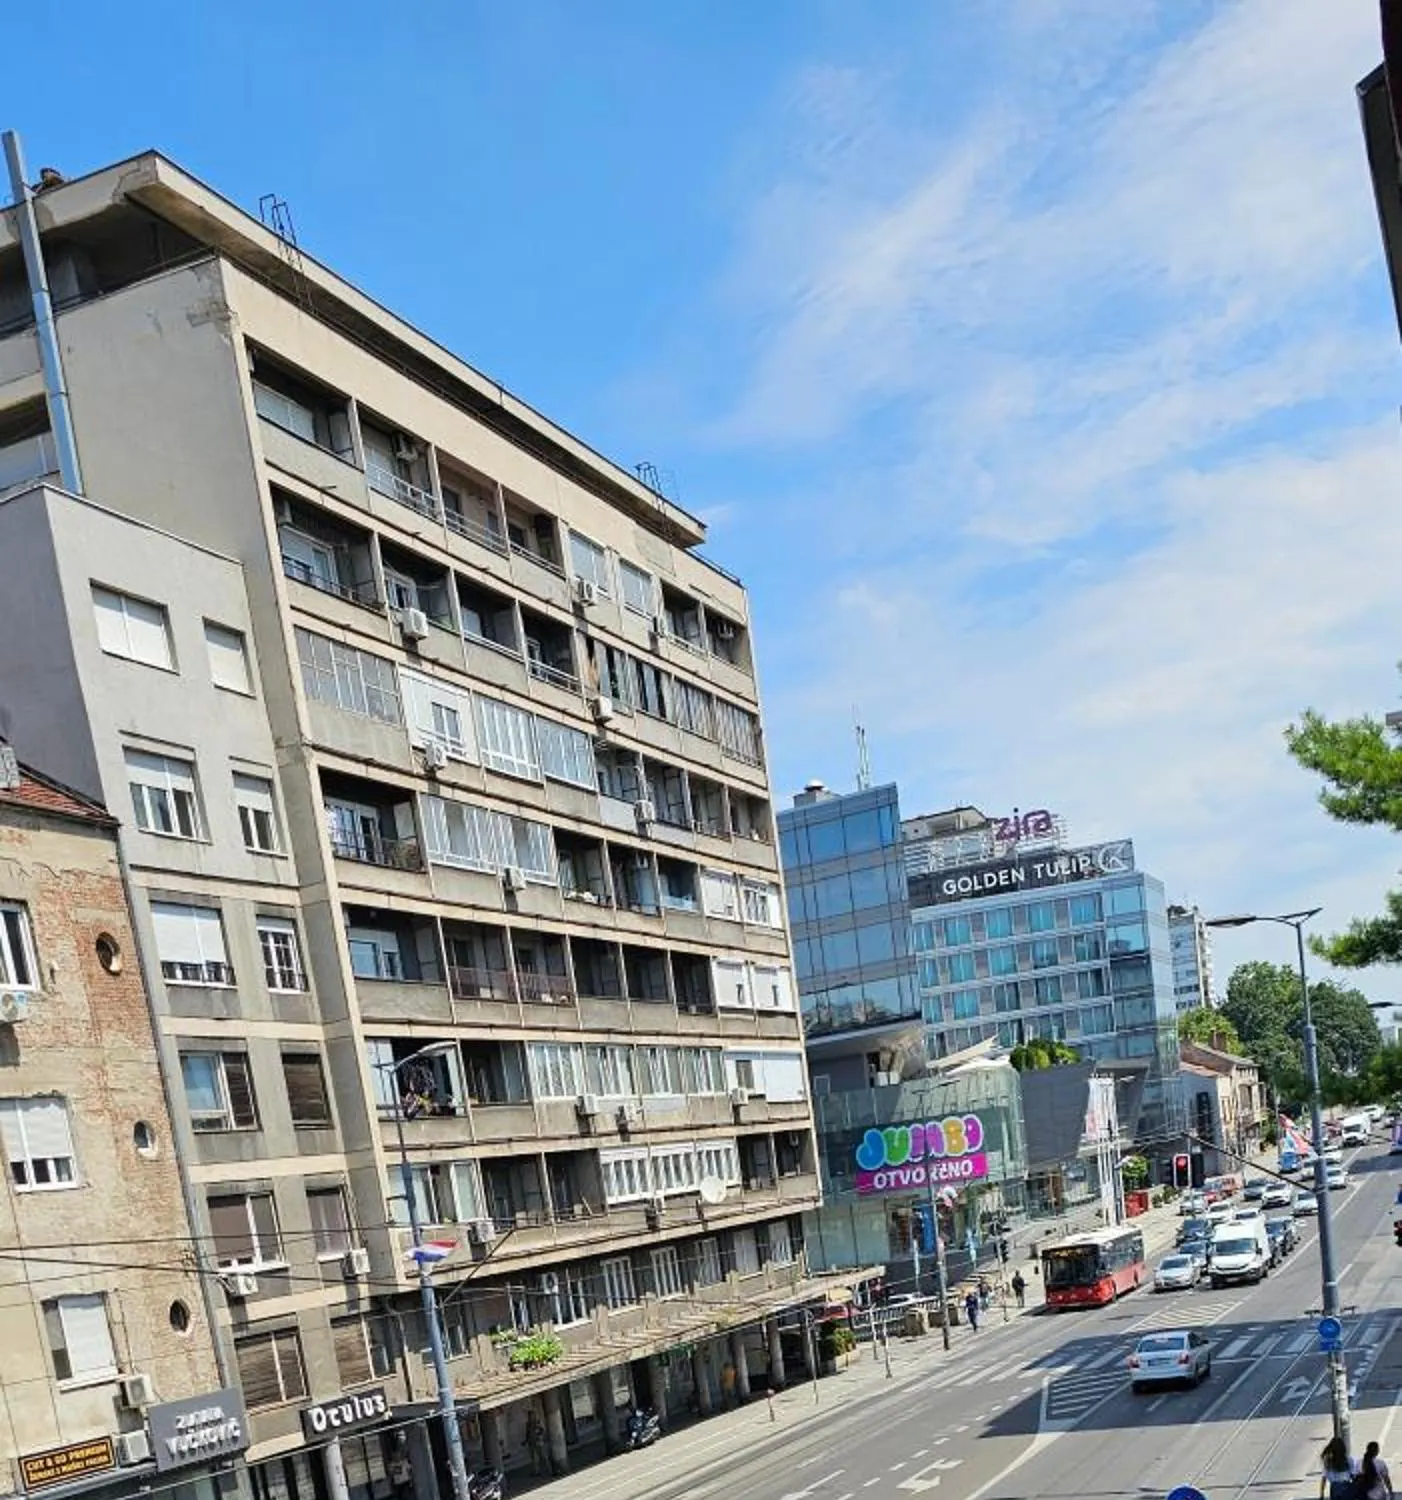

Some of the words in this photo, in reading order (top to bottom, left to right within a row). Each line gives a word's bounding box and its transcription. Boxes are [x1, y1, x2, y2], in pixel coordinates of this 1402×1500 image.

[942, 867, 1026, 896] GOLDEN
[1033, 856, 1092, 881] TULIP
[855, 1113, 985, 1171] JUMBO
[307, 1394, 385, 1433] Oculus
